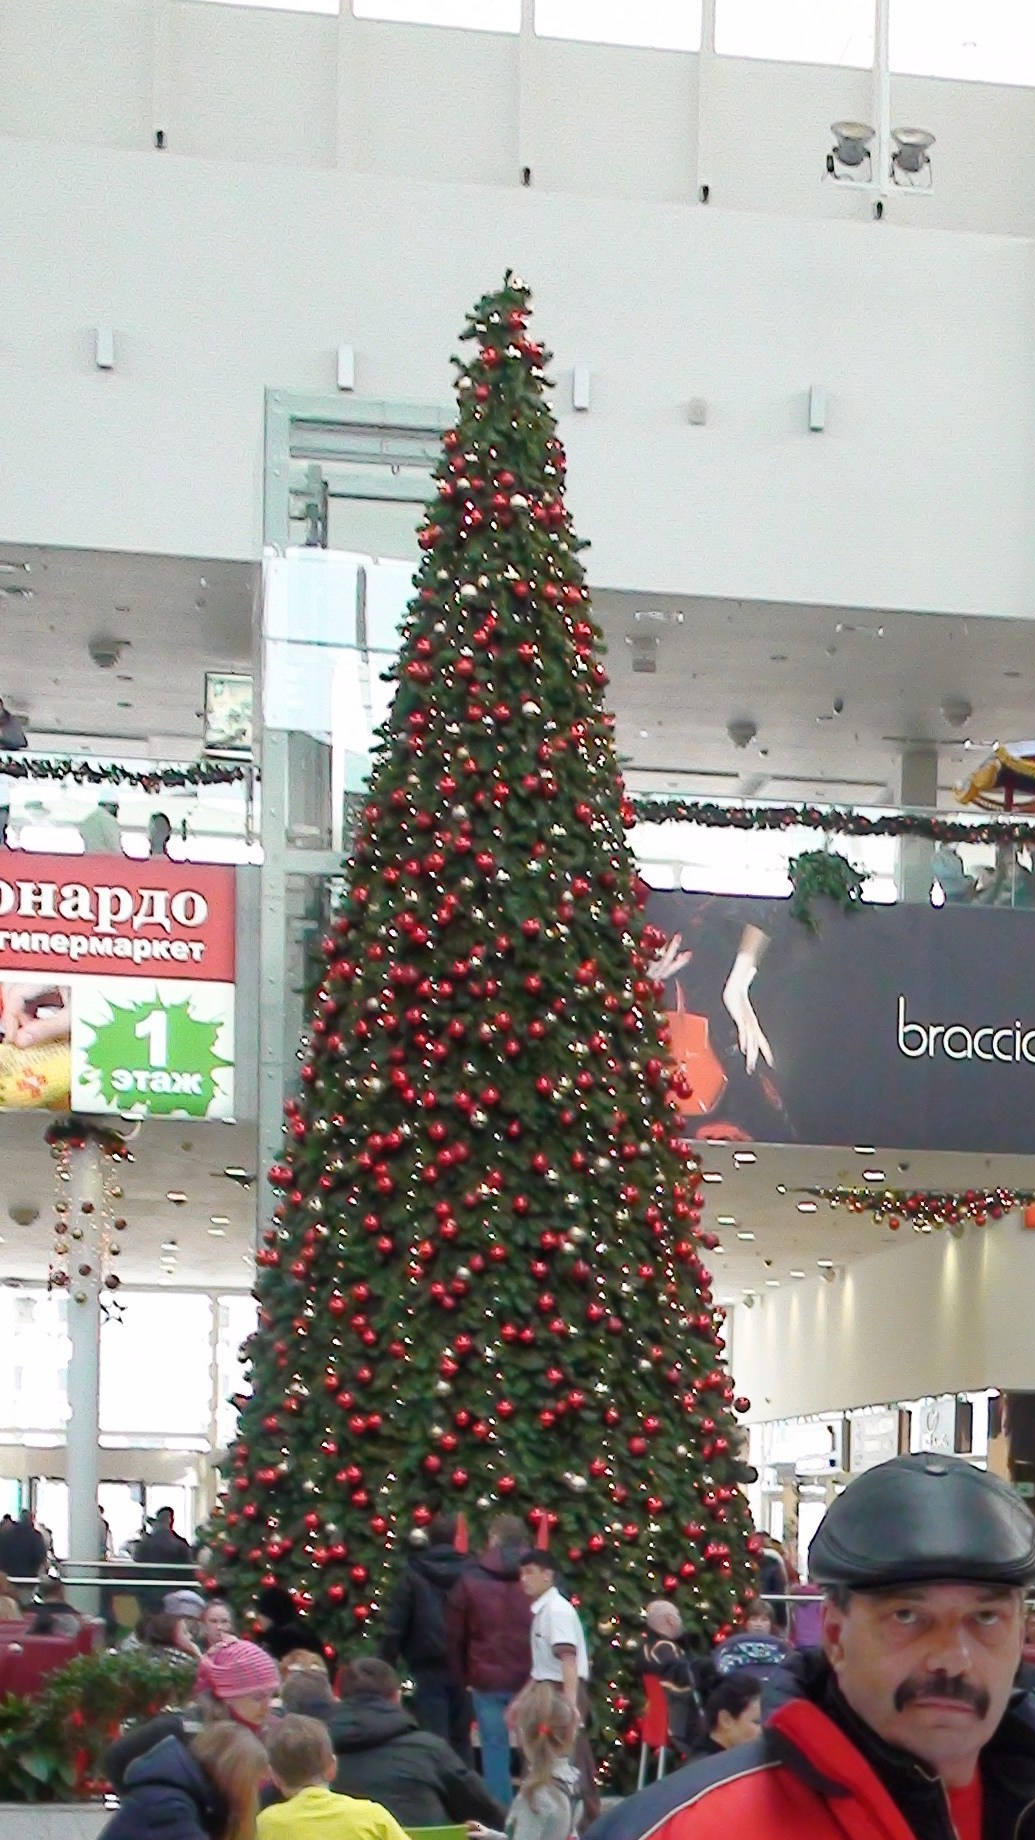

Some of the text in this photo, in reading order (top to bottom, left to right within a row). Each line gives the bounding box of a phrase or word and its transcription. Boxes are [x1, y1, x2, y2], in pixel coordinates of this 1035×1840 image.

[0, 930, 205, 964] гипермаркет
[134, 1009, 168, 1068] 1
[110, 1068, 203, 1096] этаж
